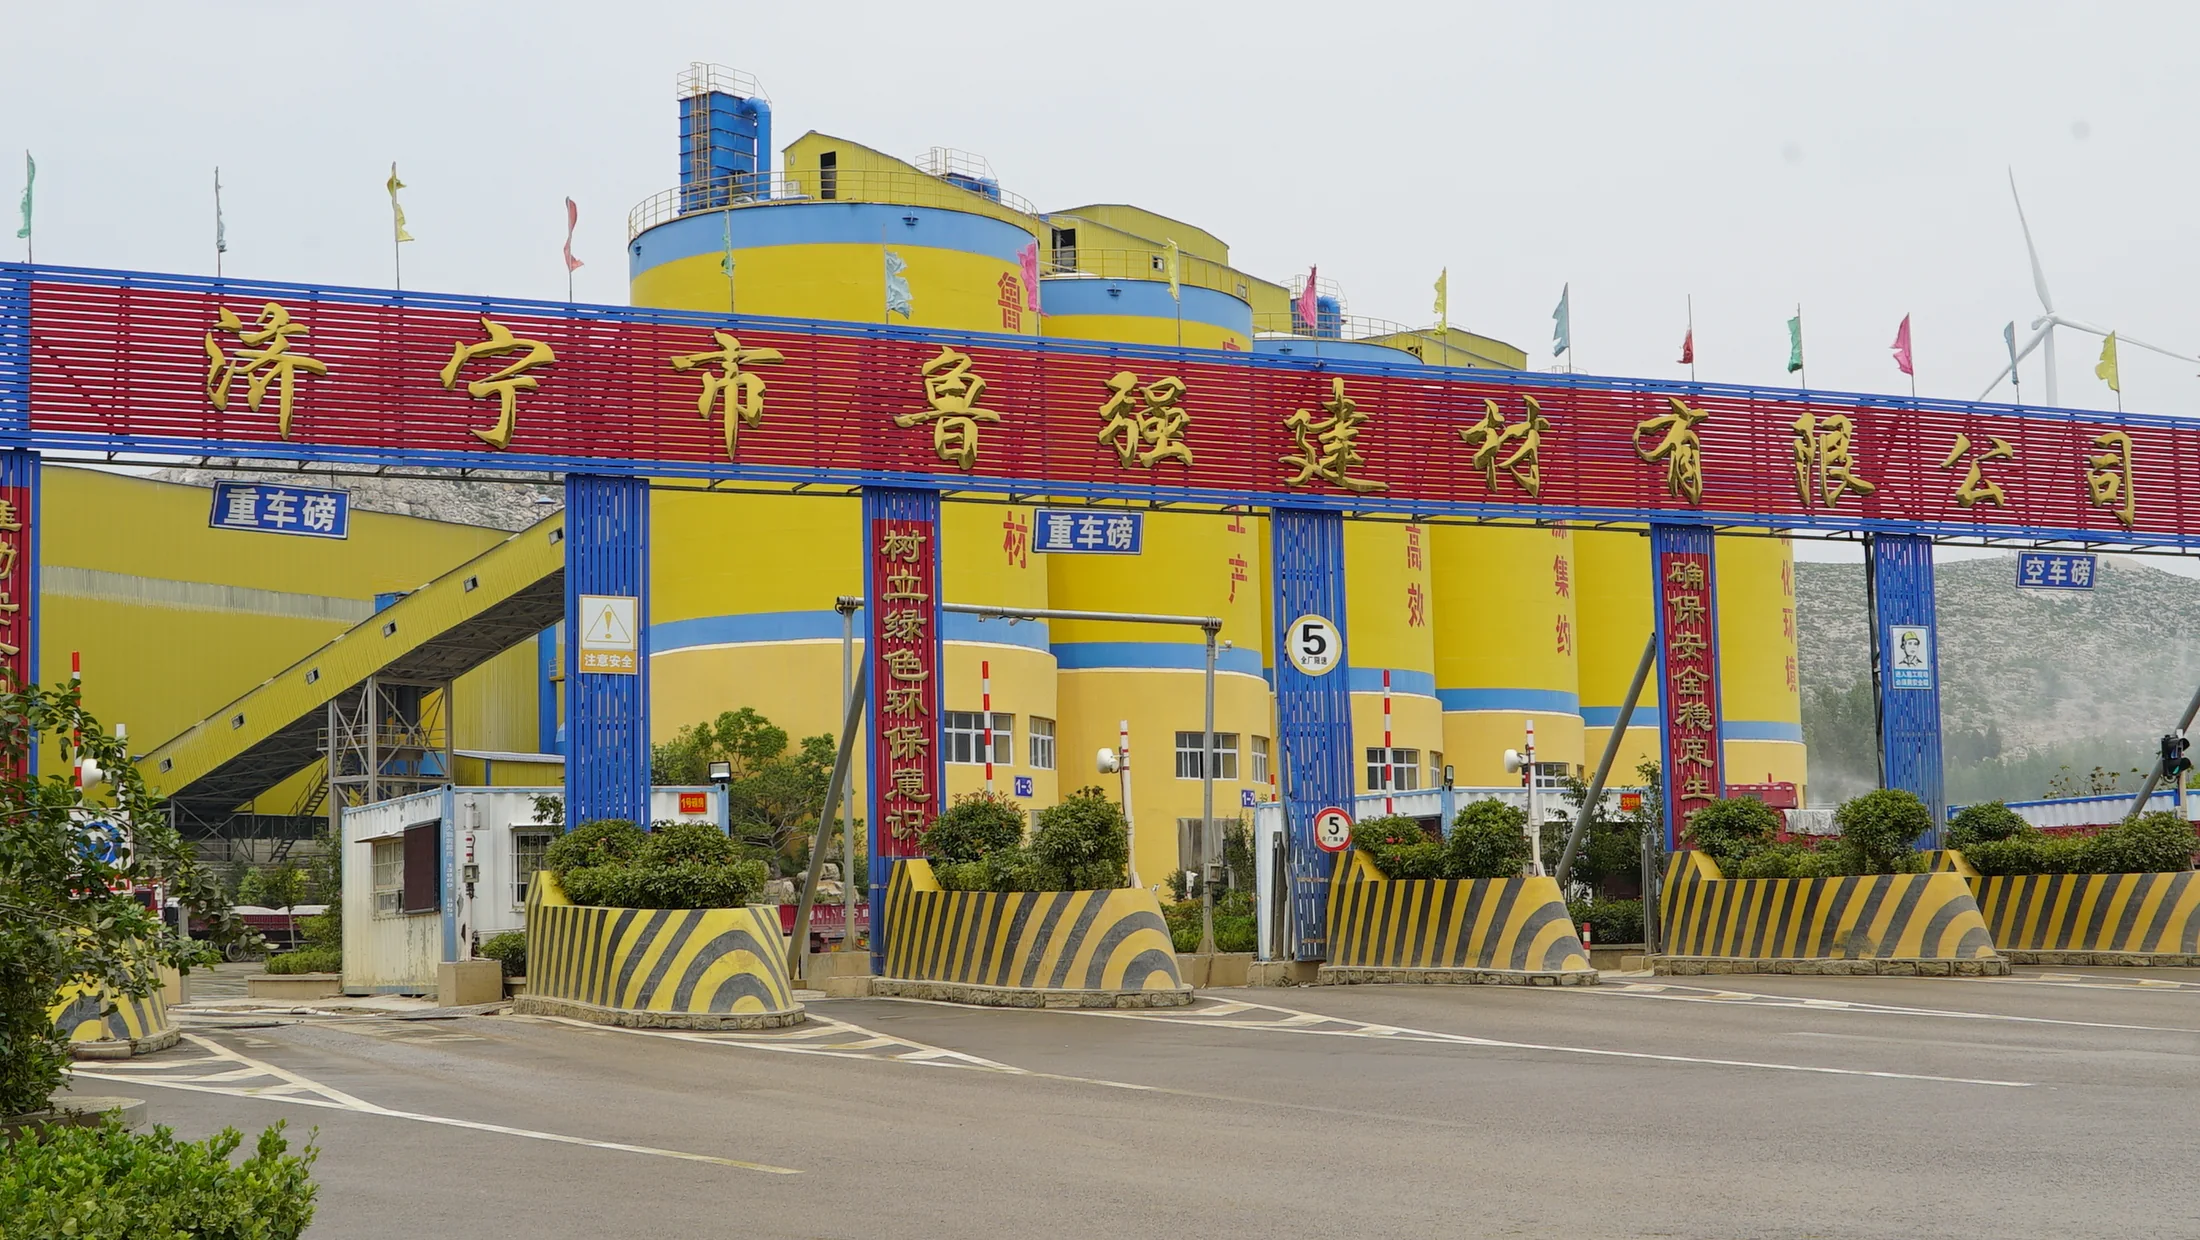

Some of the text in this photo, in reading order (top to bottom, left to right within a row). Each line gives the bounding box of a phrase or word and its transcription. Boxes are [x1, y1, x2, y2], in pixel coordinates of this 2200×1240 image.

[205, 301, 2135, 528] 济宁市鲁强建材有限公司
[223, 487, 337, 532] 重车磅
[1046, 514, 1133, 550] 重车磅
[2024, 556, 2091, 586] 空车磅
[1302, 624, 1327, 655] 5
[584, 653, 633, 668] 注意安全
[880, 529, 932, 840] 树立绿色环保意识
[1015, 779, 1032, 795] 1-3
[1242, 791, 1255, 806] 1-2
[1328, 816, 1340, 835] 5
